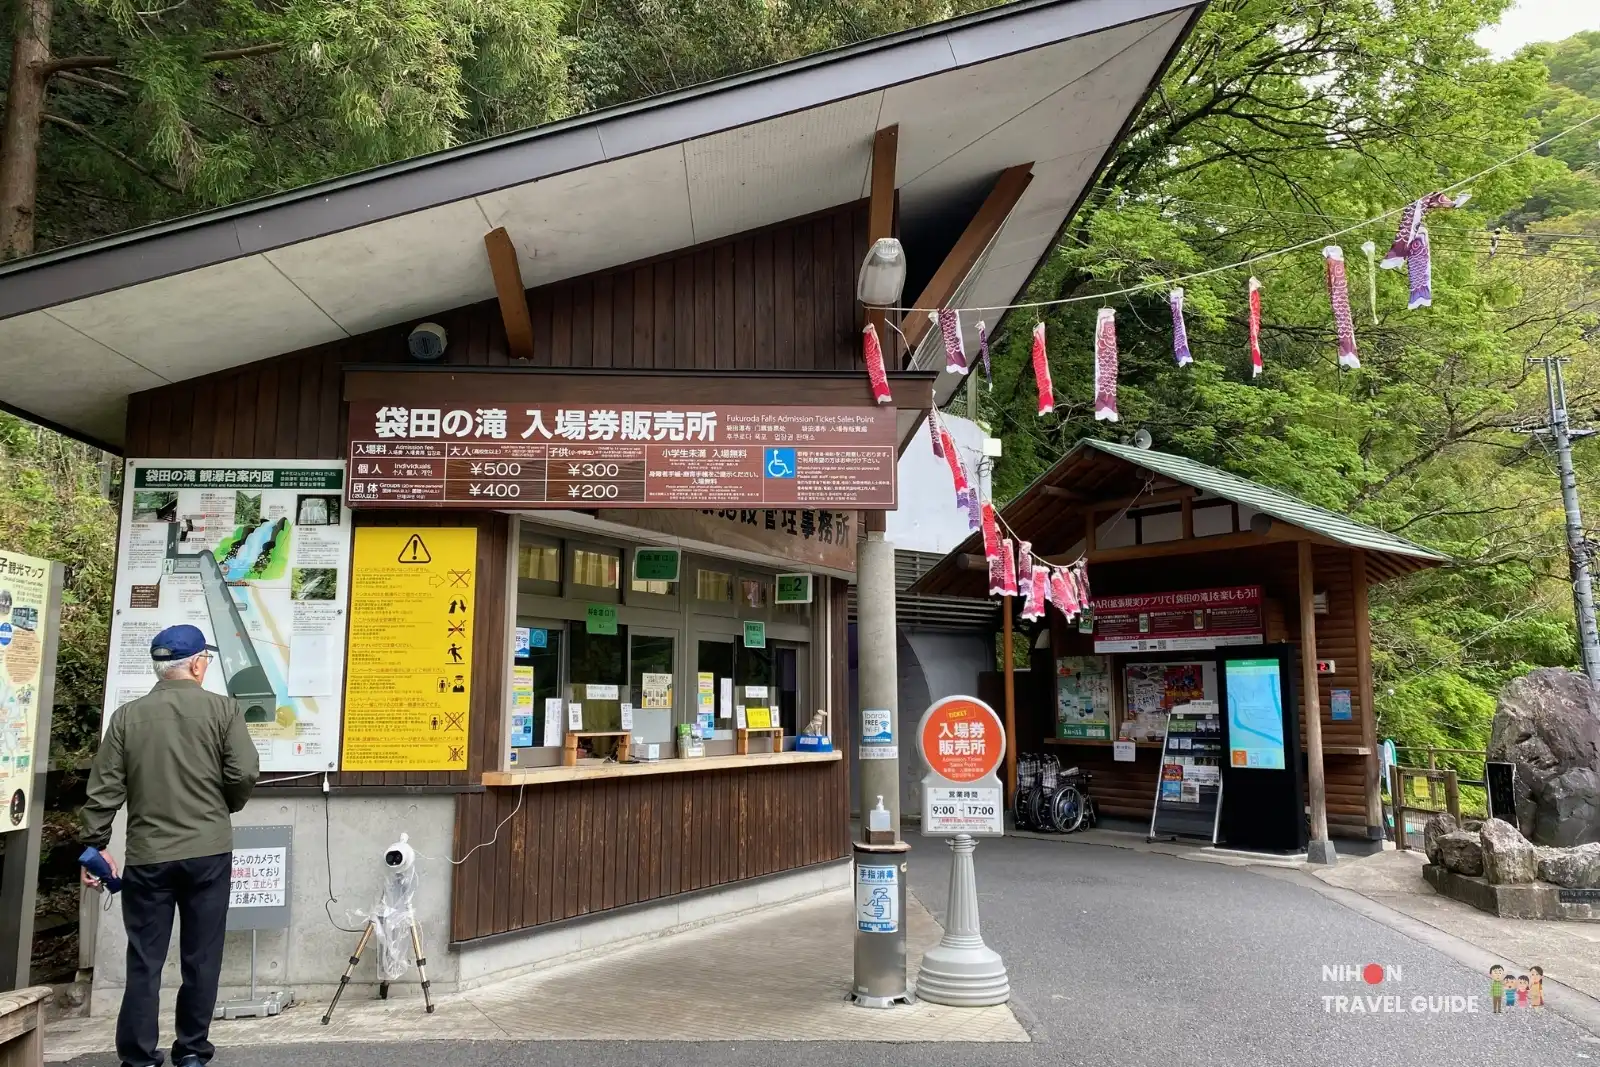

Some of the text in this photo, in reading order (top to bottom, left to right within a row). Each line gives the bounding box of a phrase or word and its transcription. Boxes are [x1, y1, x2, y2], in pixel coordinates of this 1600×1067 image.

[375, 407, 718, 442] 袋田の滝 入場券販売所
[726, 415, 760, 423] Fukuroda
[761, 415, 776, 423] Falls
[778, 415, 814, 423] Admission
[816, 415, 835, 423] Ticket
[856, 416, 875, 424] Point
[355, 444, 387, 455] 入場料
[662, 449, 748, 459] 小学生未満 入場無料
[145, 469, 274, 482] 袋田の滝 観瀑台案内図
[358, 464, 382, 474] 個人
[470, 462, 521, 476] ¥500
[567, 463, 620, 477] ¥300
[353, 483, 379, 493] 団体
[468, 483, 520, 498] ¥400
[567, 484, 619, 498] ¥200
[938, 722, 986, 739] 入場券
[938, 739, 986, 756] 販売所
[932, 806, 955, 815] 9:00
[967, 806, 994, 815] 17:00
[860, 869, 894, 879] 手指消毒
